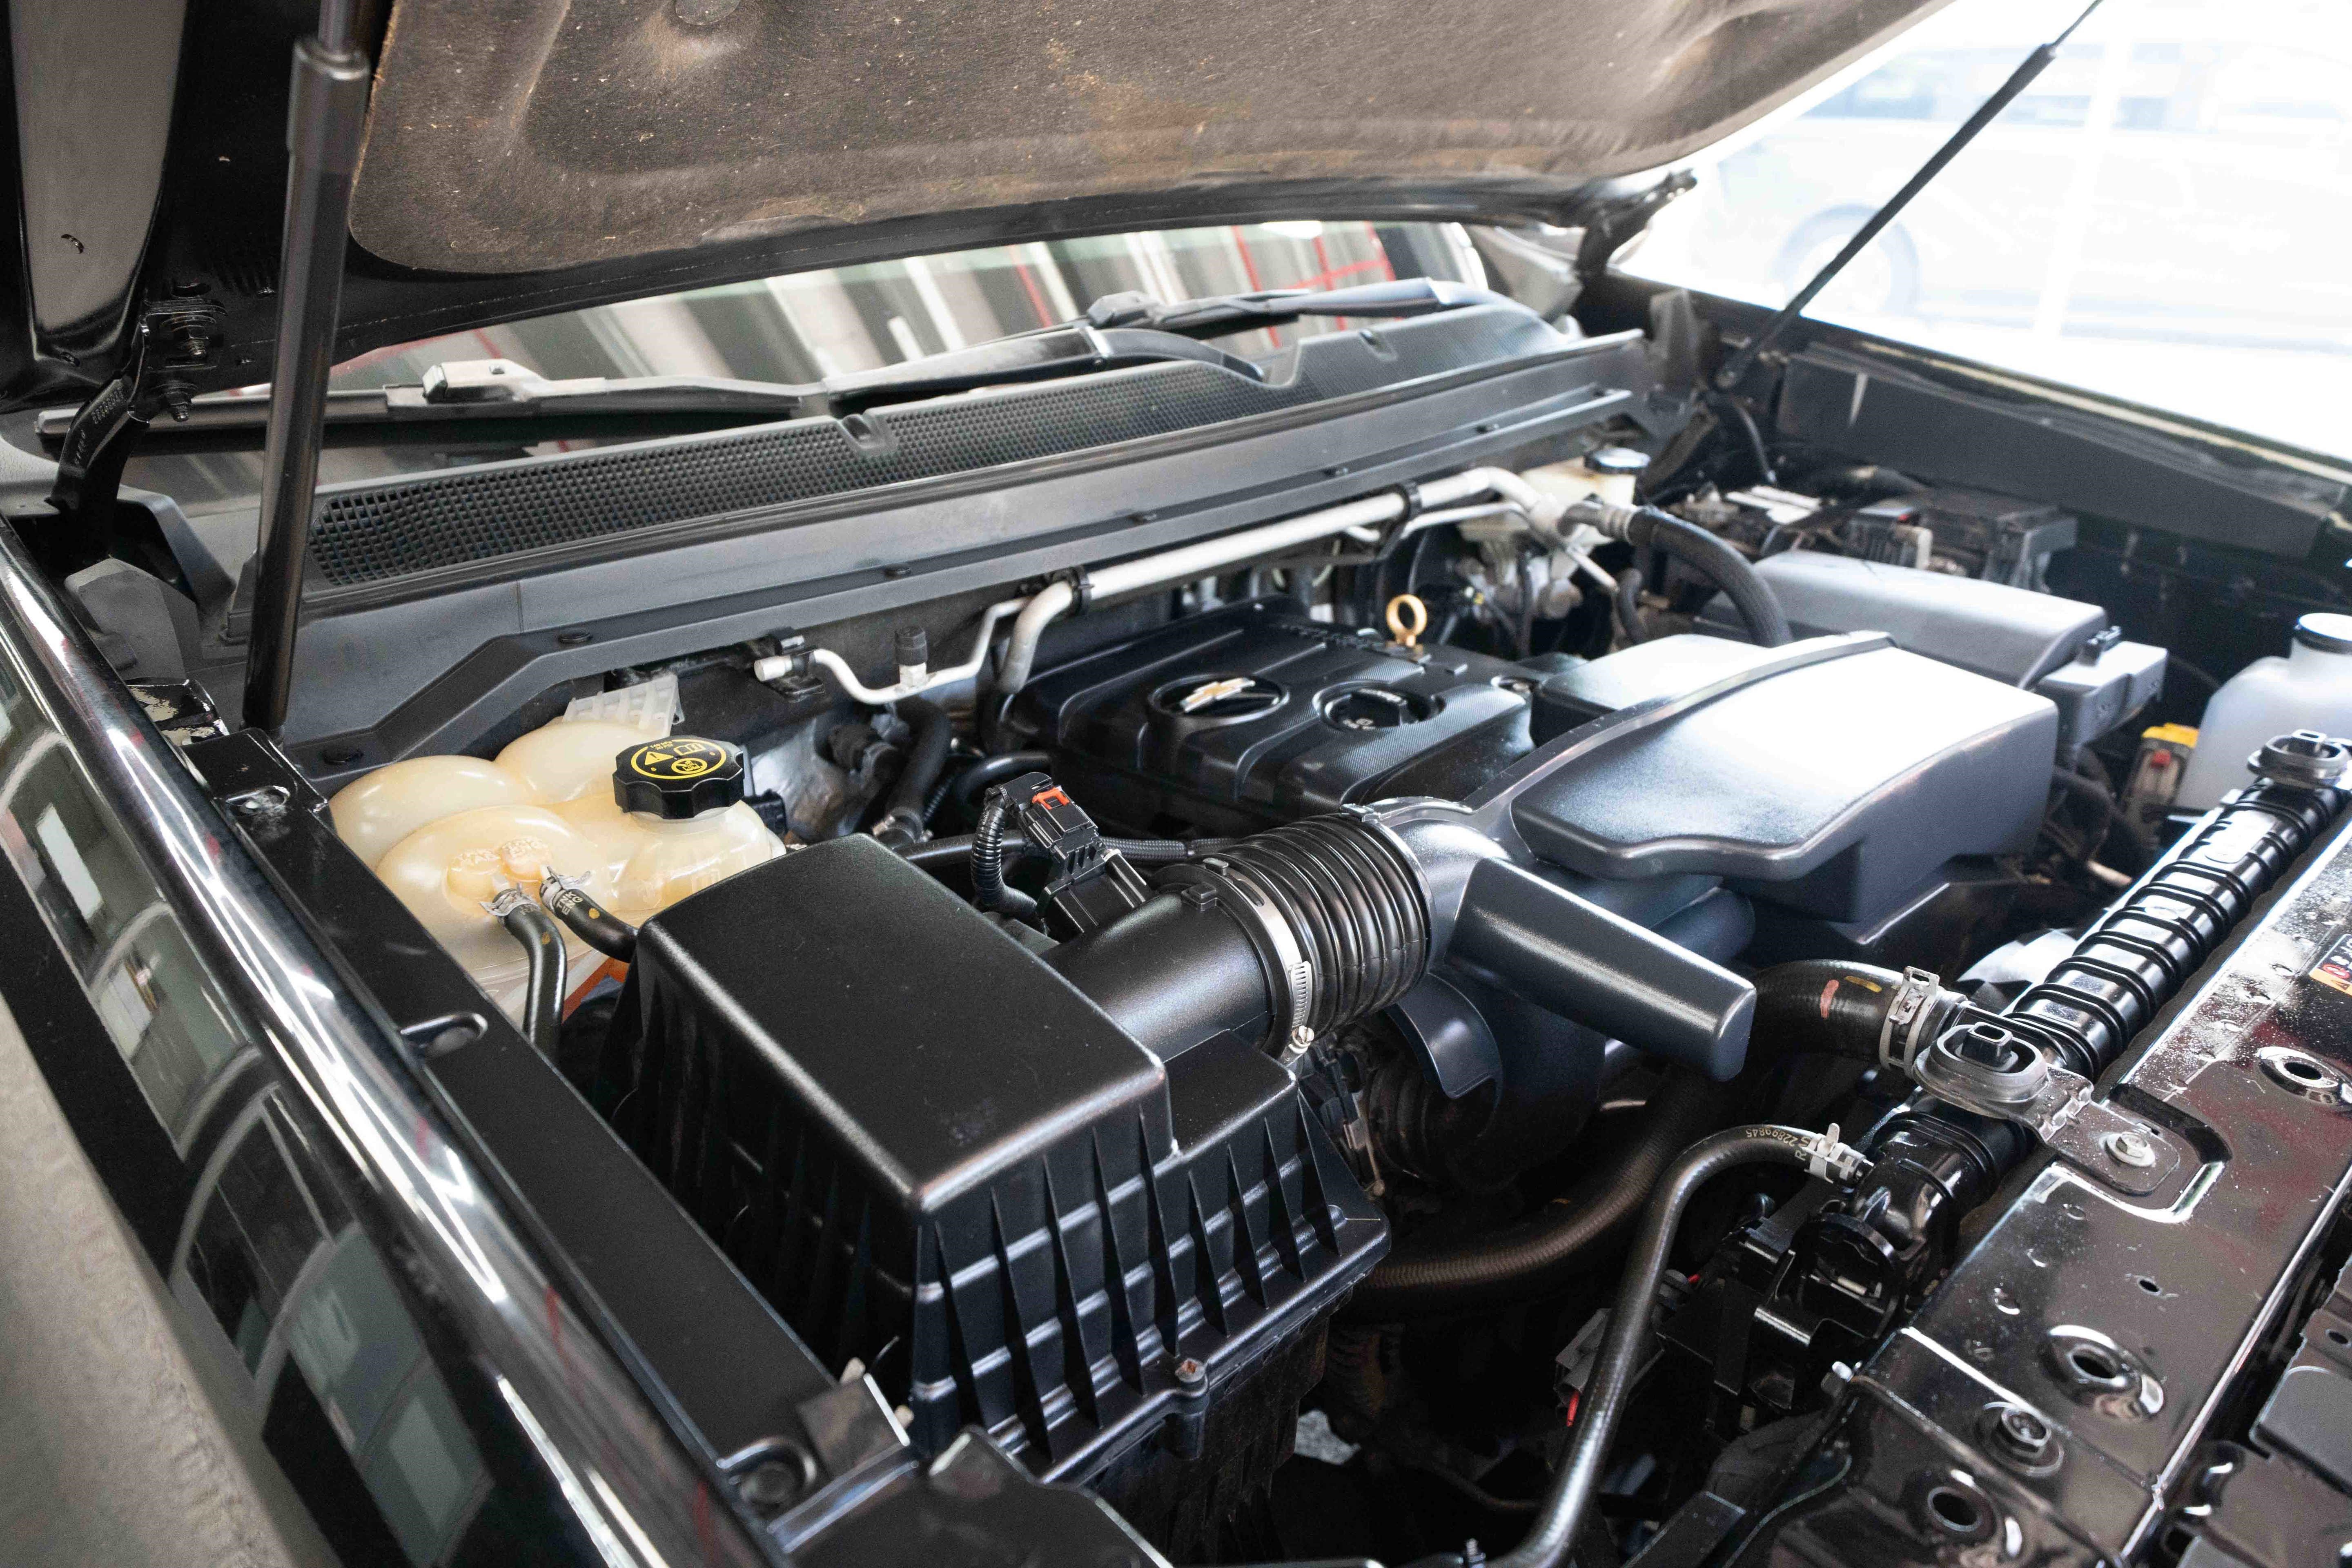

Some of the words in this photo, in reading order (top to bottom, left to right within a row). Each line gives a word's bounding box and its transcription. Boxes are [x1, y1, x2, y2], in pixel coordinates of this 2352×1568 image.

[556, 891, 577, 909] TNK
[561, 895, 584, 915] ENG
[1746, 1125, 1798, 1147] 22899845
